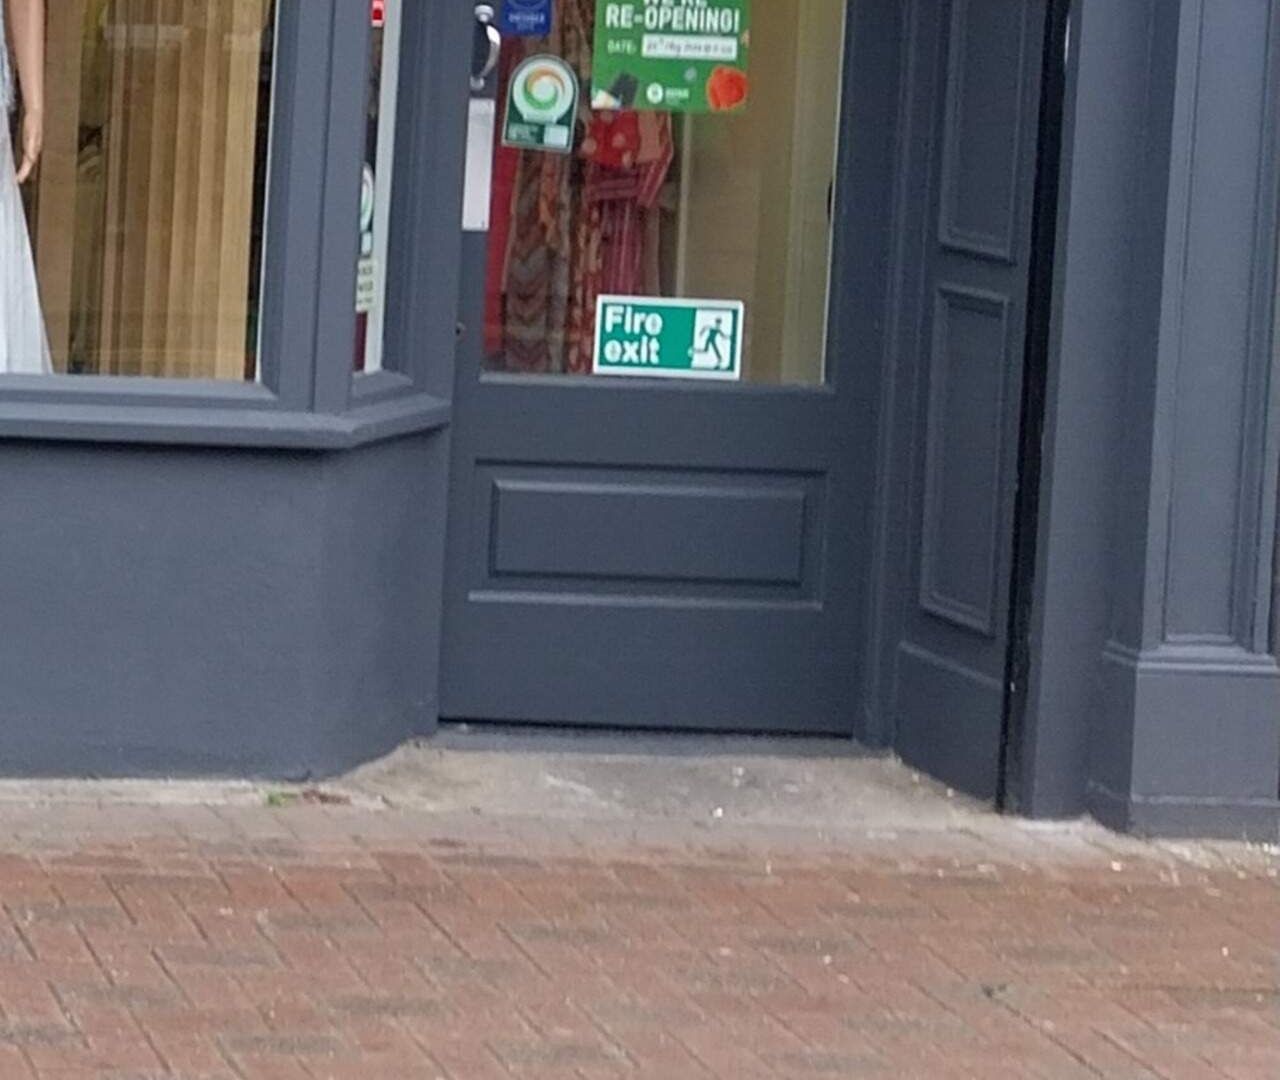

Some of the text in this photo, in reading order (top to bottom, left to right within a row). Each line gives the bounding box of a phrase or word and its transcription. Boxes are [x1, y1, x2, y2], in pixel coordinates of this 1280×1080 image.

[605, 3, 740, 34] RE-OPENING!
[604, 304, 663, 336] Fire
[603, 335, 661, 365] exit
